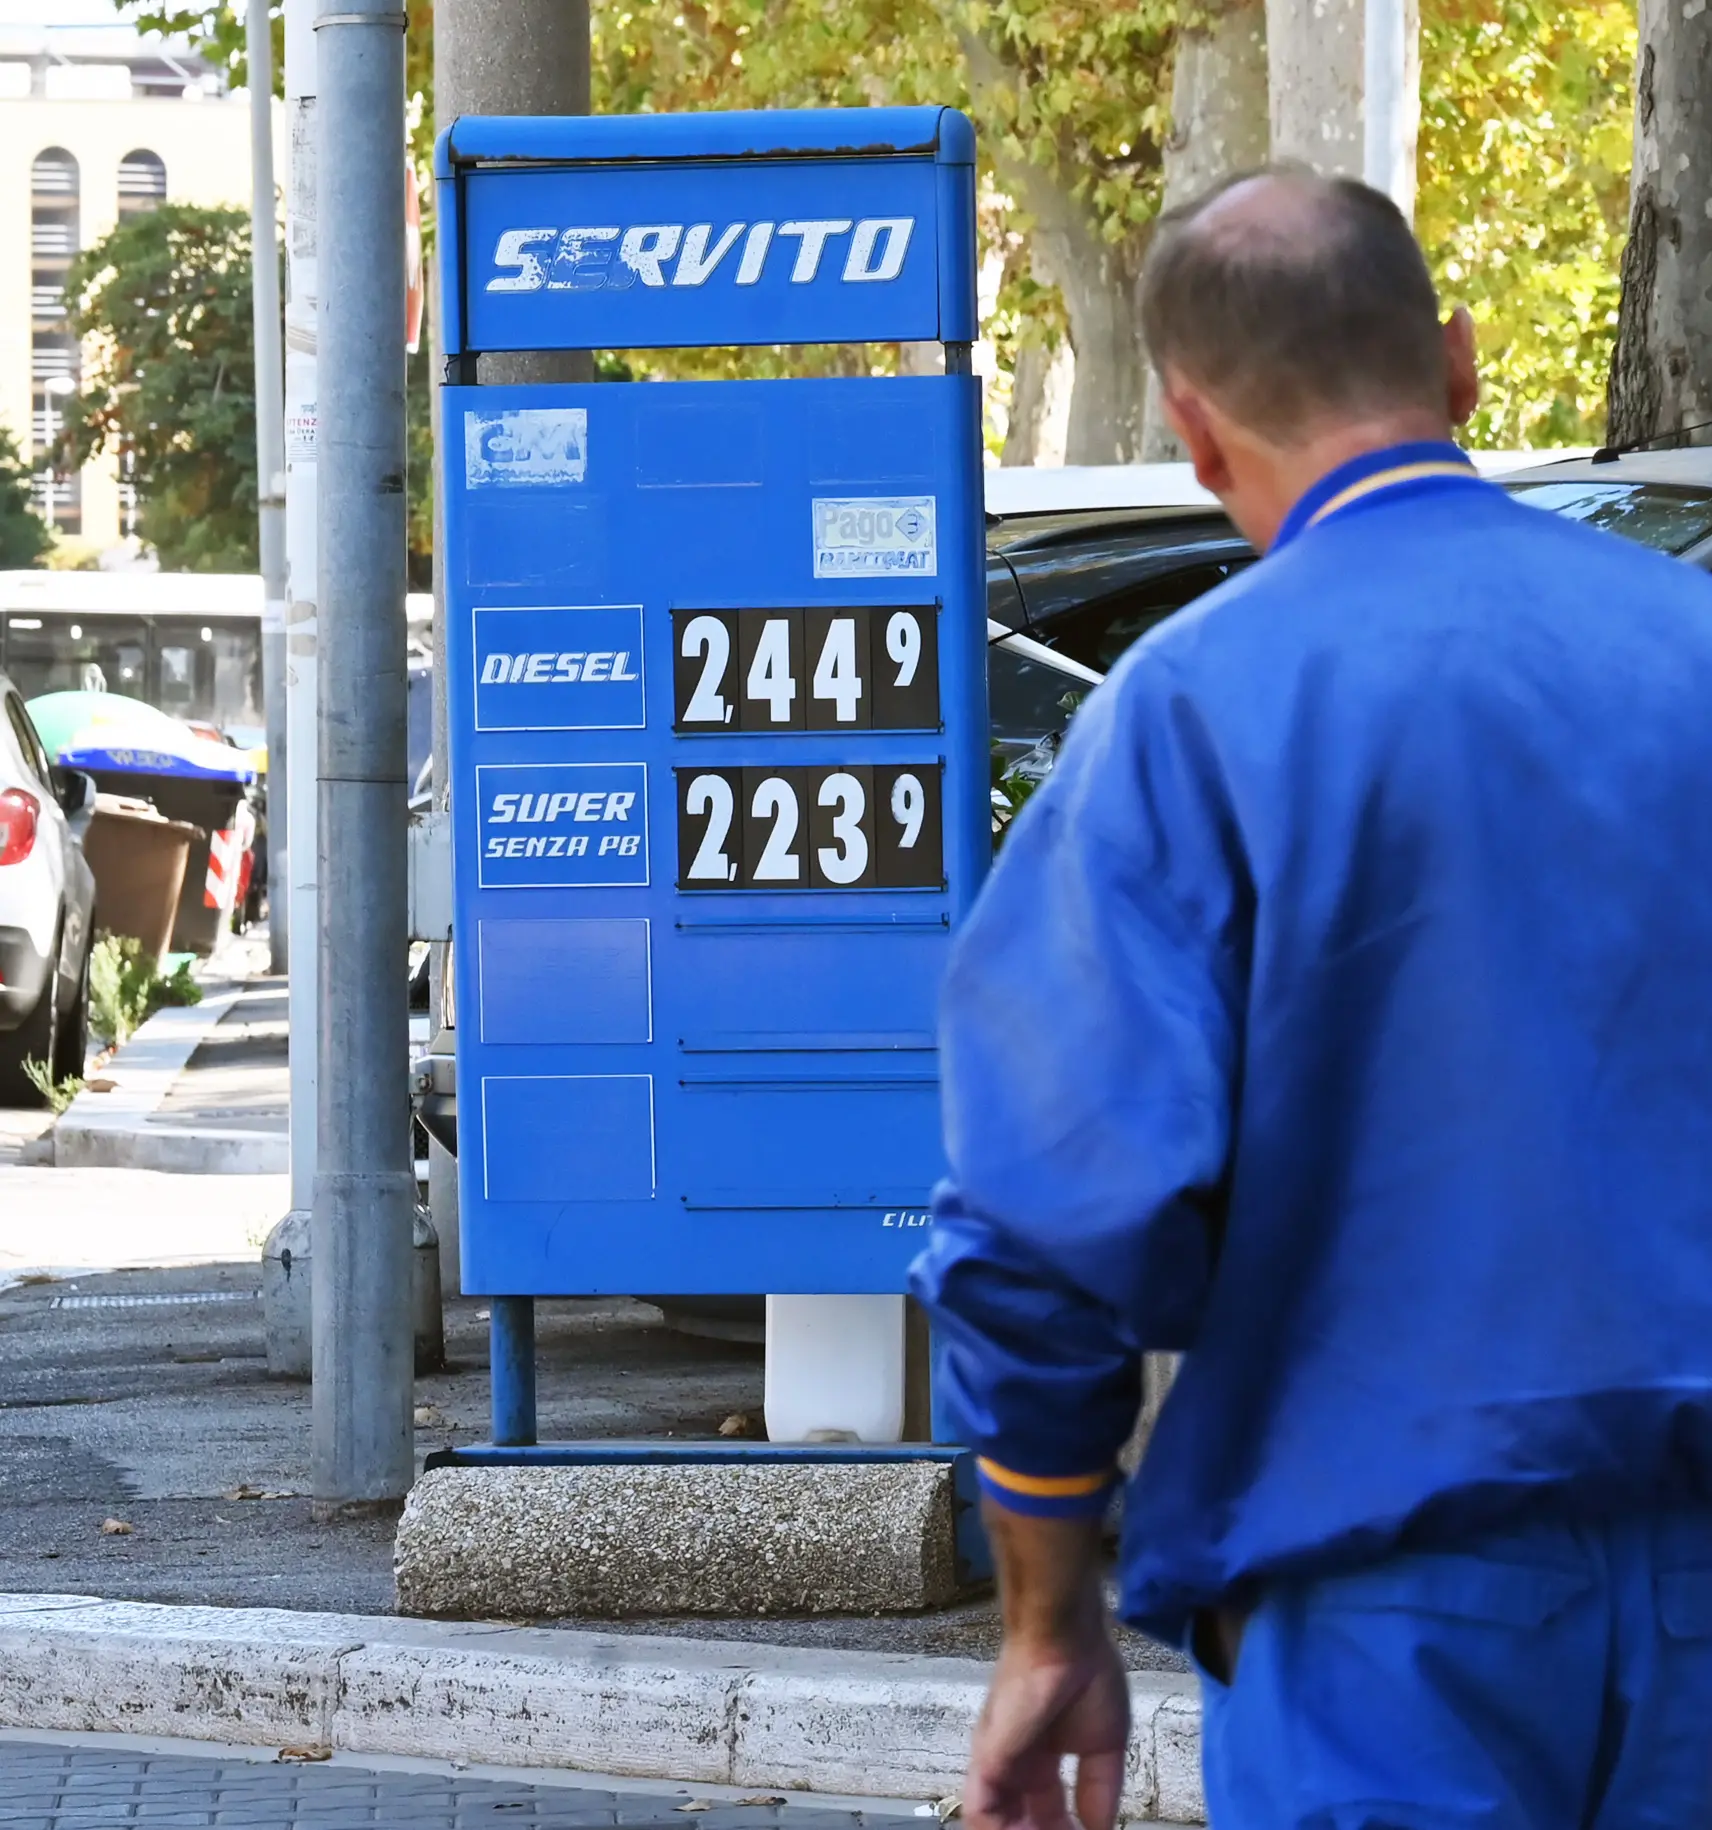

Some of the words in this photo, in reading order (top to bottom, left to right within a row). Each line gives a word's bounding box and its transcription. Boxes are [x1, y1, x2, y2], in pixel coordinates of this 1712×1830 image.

[485, 216, 915, 292] SERVITO
[480, 651, 638, 684] DIESEL
[488, 791, 635, 823] SUPER
[485, 836, 586, 858] SENZA
[598, 835, 640, 857] PB
